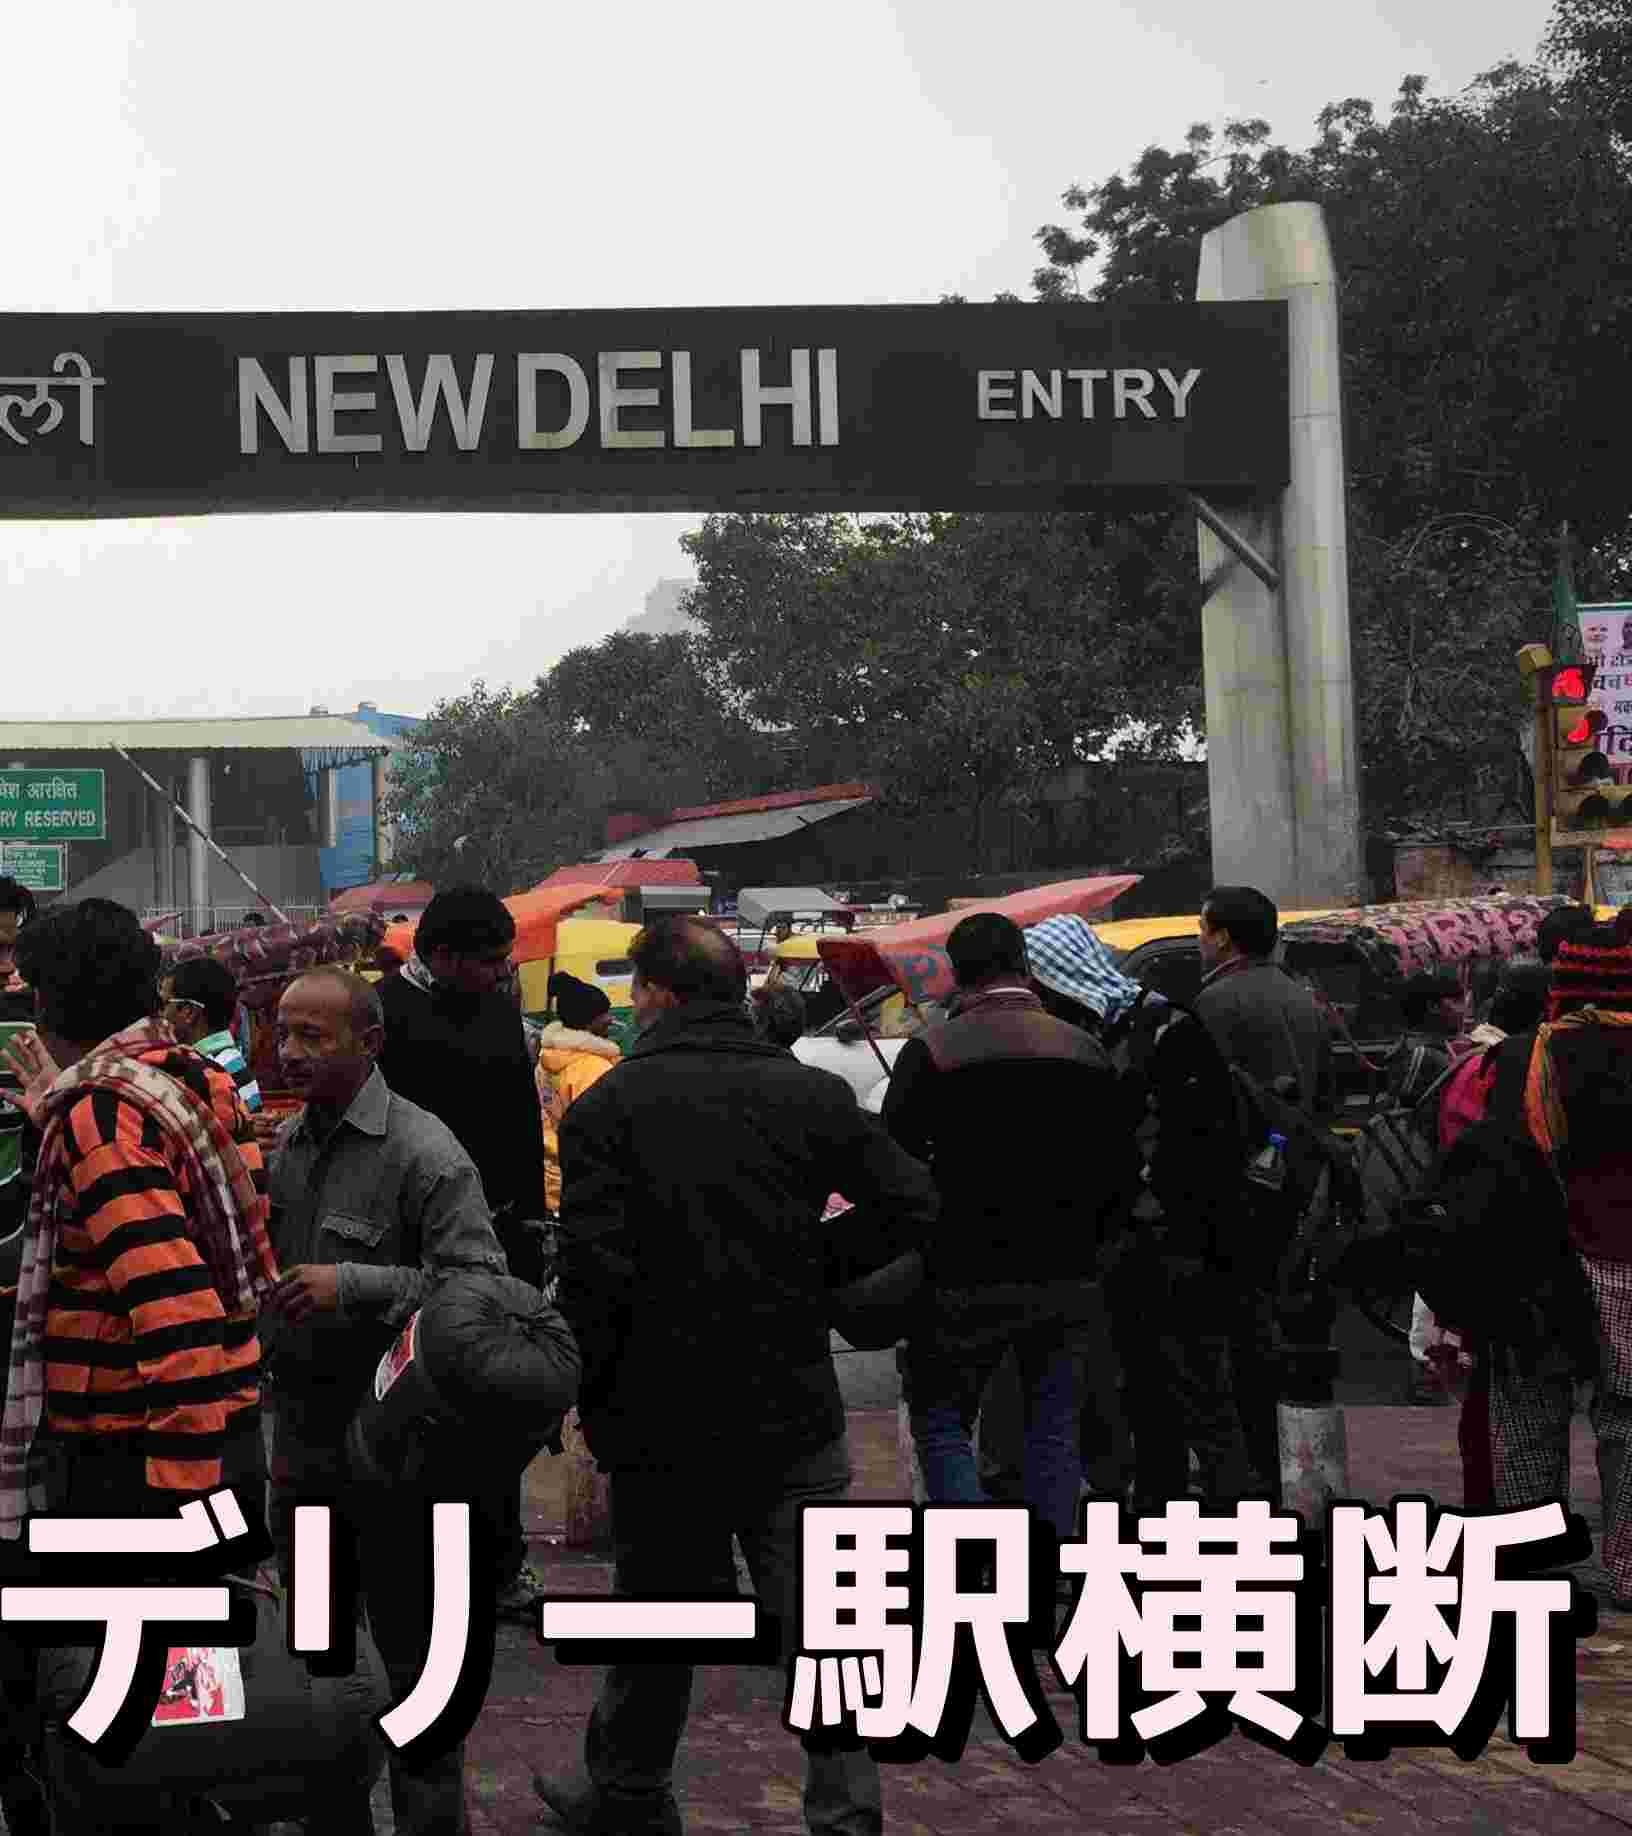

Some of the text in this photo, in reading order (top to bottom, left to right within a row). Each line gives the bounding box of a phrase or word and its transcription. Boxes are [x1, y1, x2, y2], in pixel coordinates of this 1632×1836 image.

[238, 347, 840, 455] NEW DELHI
[976, 367, 1202, 422] ENTRY
[24, 809, 97, 828] RESERVED
